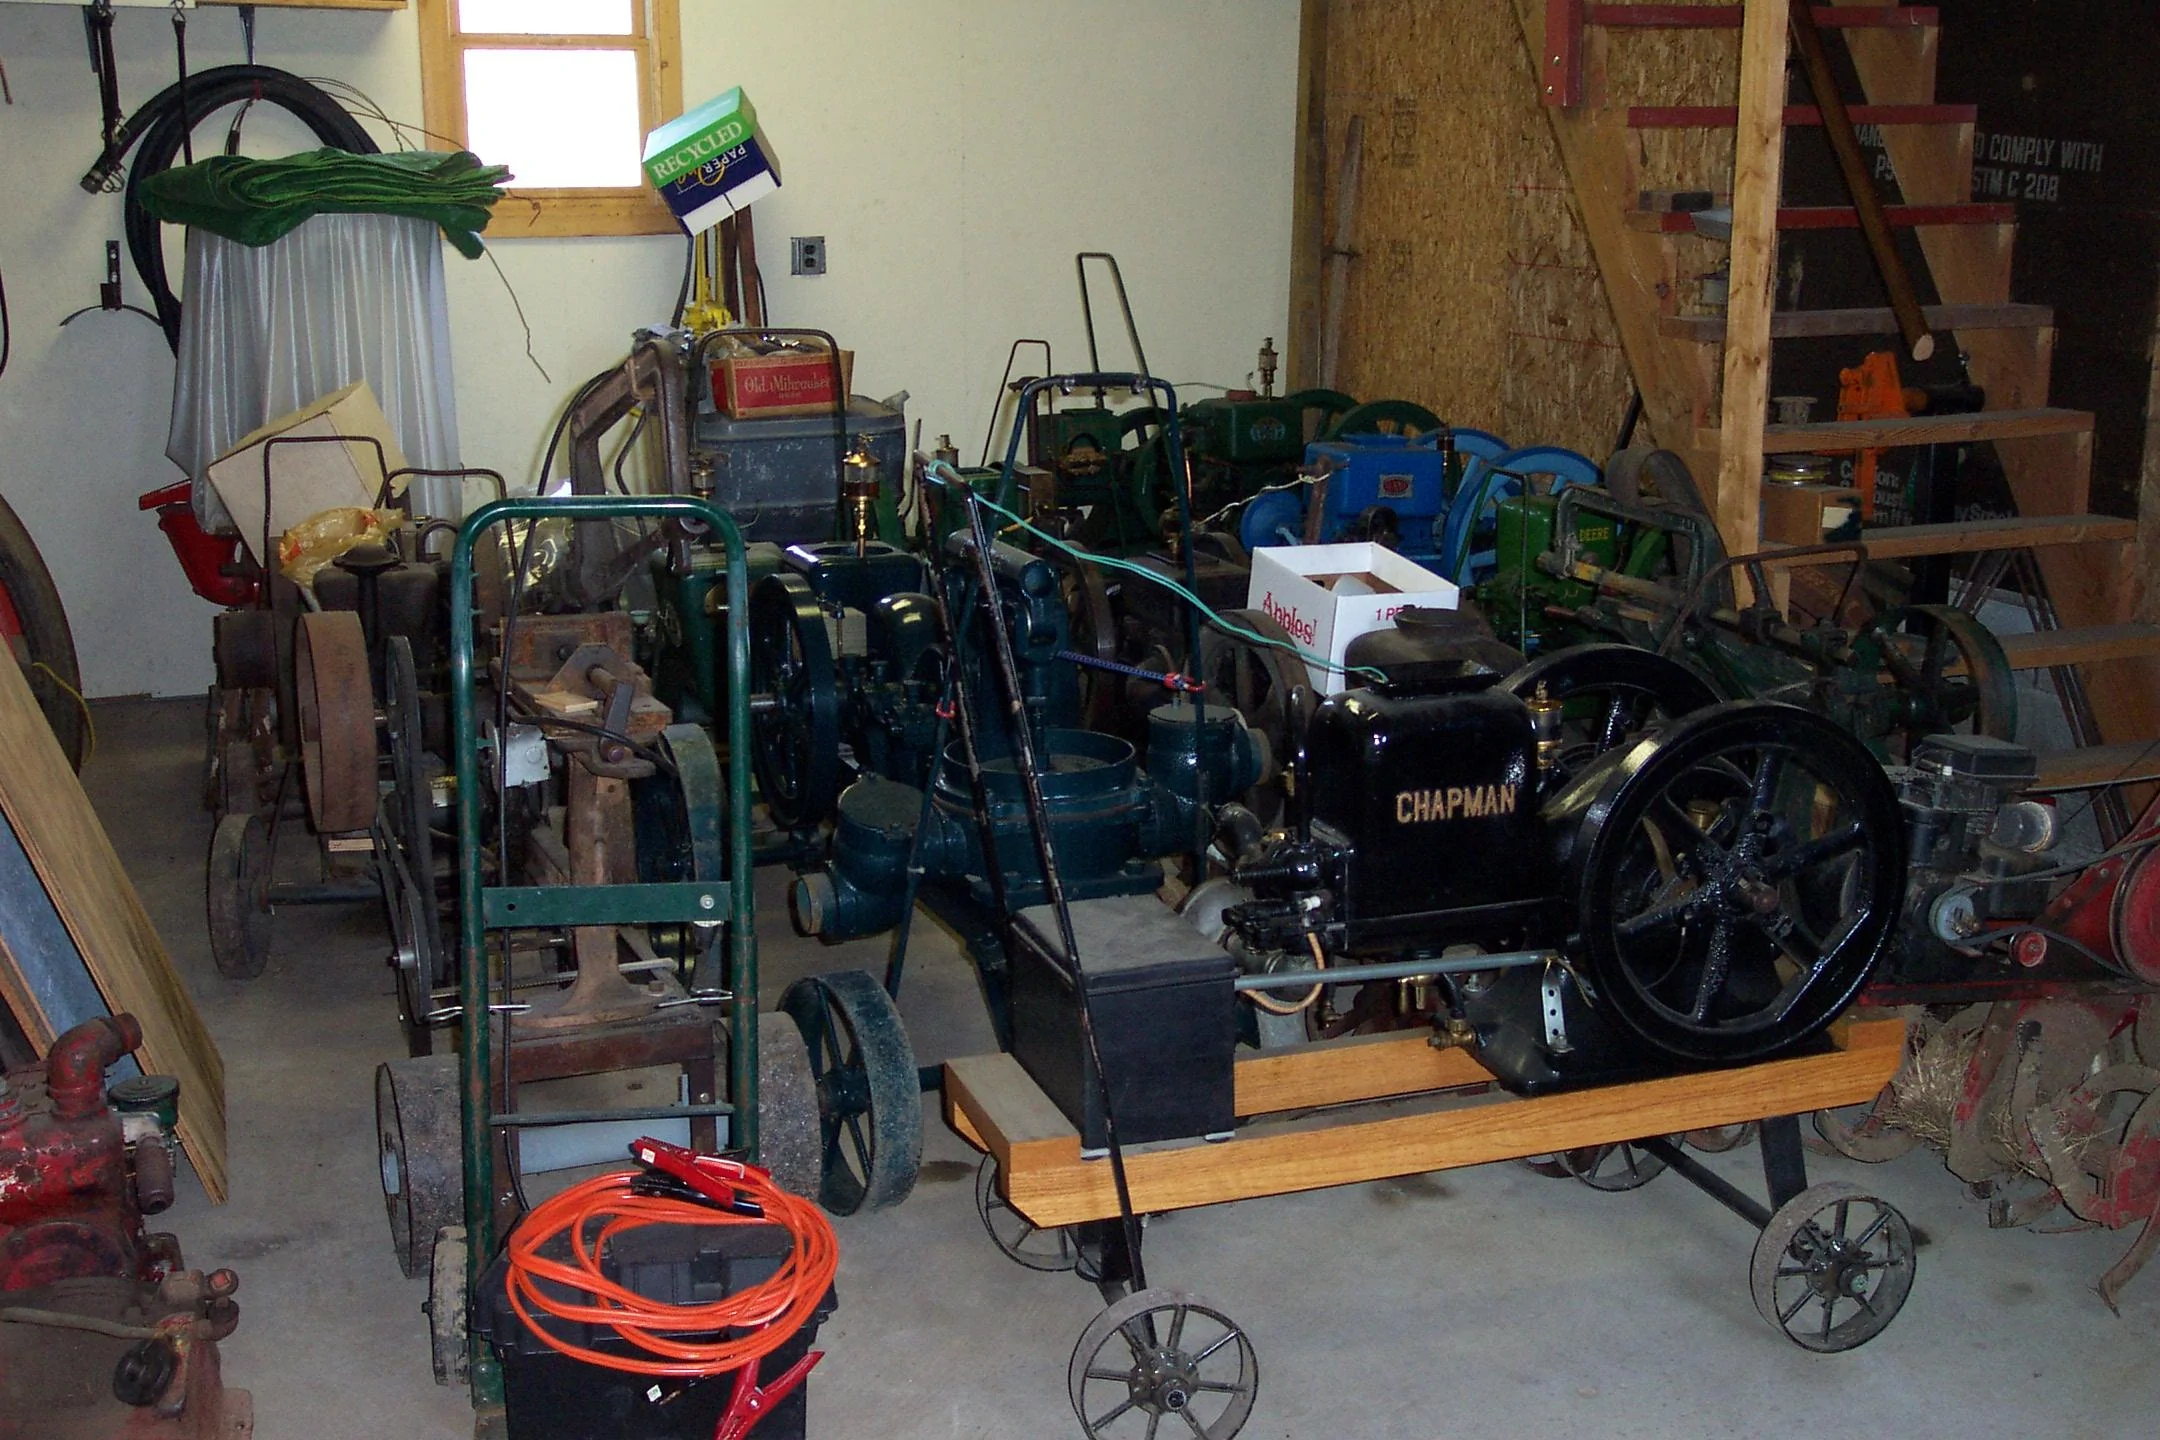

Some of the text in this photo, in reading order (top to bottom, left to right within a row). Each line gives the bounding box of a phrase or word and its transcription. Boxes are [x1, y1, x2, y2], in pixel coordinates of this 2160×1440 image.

[653, 121, 743, 179] RECYCLED
[702, 144, 746, 174] PAPER
[1990, 133, 2055, 166] COMPLY
[2061, 140, 2105, 173] WITH
[1972, 166, 2004, 196] STM
[2007, 171, 2021, 198] C
[2024, 171, 2060, 202] 208
[744, 375, 767, 393] Old
[1579, 527, 1609, 542] DEERE
[1396, 784, 1516, 824] CHAPMAN
